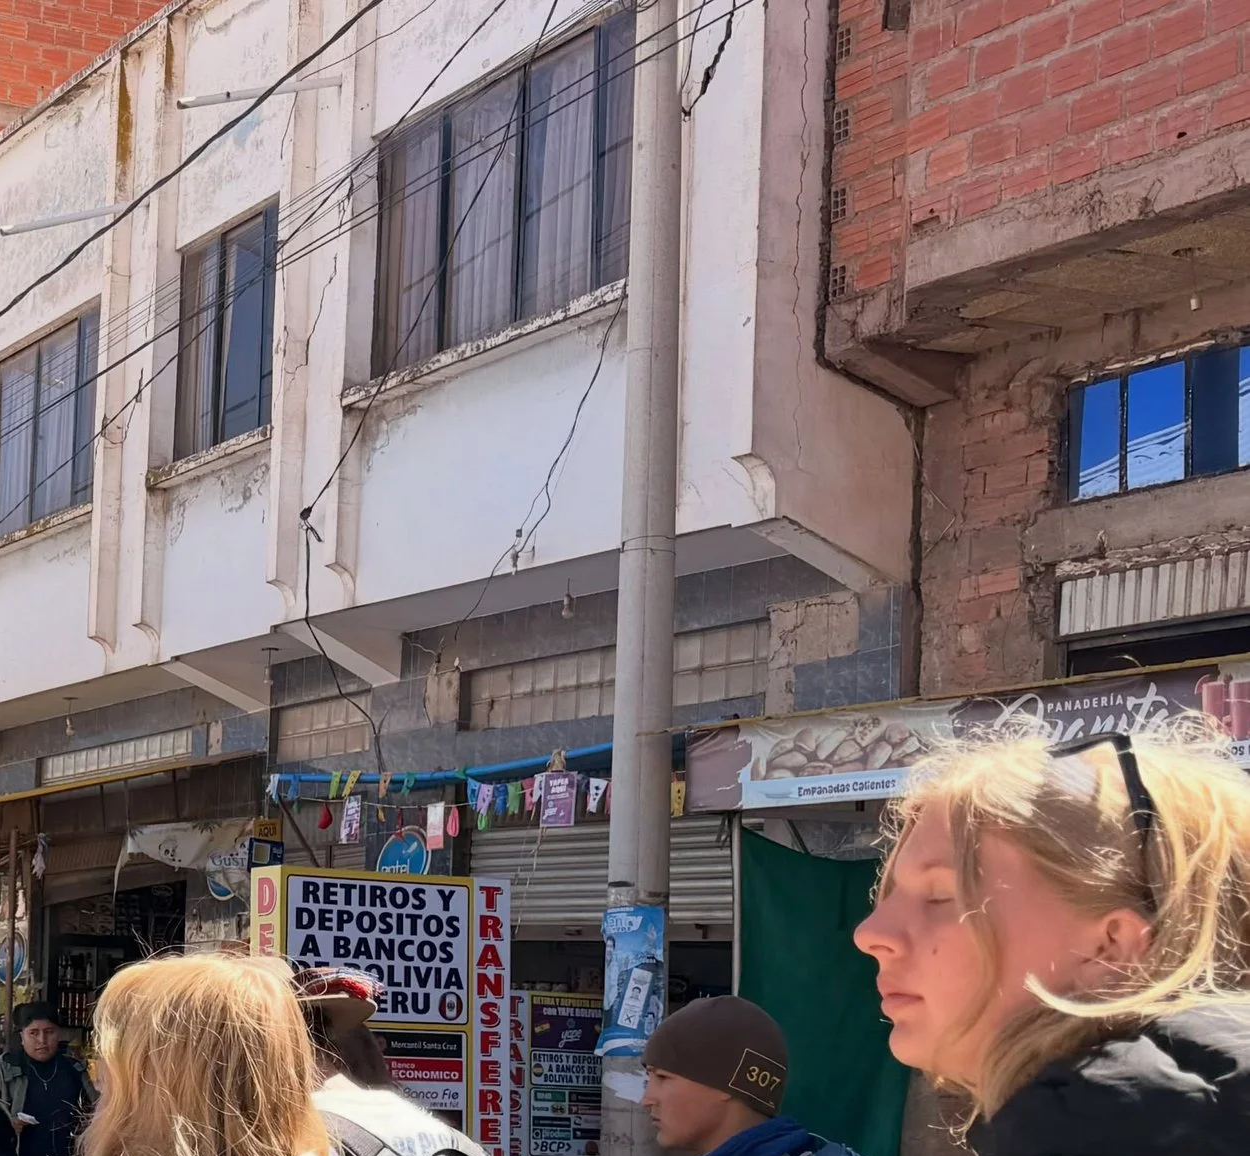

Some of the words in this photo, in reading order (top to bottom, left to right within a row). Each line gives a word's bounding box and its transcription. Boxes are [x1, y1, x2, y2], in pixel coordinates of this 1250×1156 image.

[1047, 693, 1123, 714] PANADERÍA
[852, 778, 897, 792] Calientes
[302, 881, 427, 911] RETIROS
[437, 888, 456, 912] Y
[295, 907, 460, 938] DEPOSITOS
[299, 935, 321, 957] A
[333, 935, 454, 964] BANCOS
[344, 962, 464, 990] OLIVIA
[376, 991, 431, 1015] ERU
[391, 1041, 422, 1049] Mercantil
[423, 1041, 442, 1050] Santa
[442, 1042, 457, 1051] Cruz
[391, 1061, 416, 1069] Banco
[533, 1052, 563, 1063] RETIROS
[565, 1054, 571, 1063] Y
[391, 1069, 459, 1080] ECONOMICO
[543, 1073, 573, 1083] BOLIVIA
[548, 1064, 554, 1073] A
[555, 1064, 585, 1075] BANCOS
[586, 1065, 597, 1075] DE
[746, 1065, 781, 1091] 307
